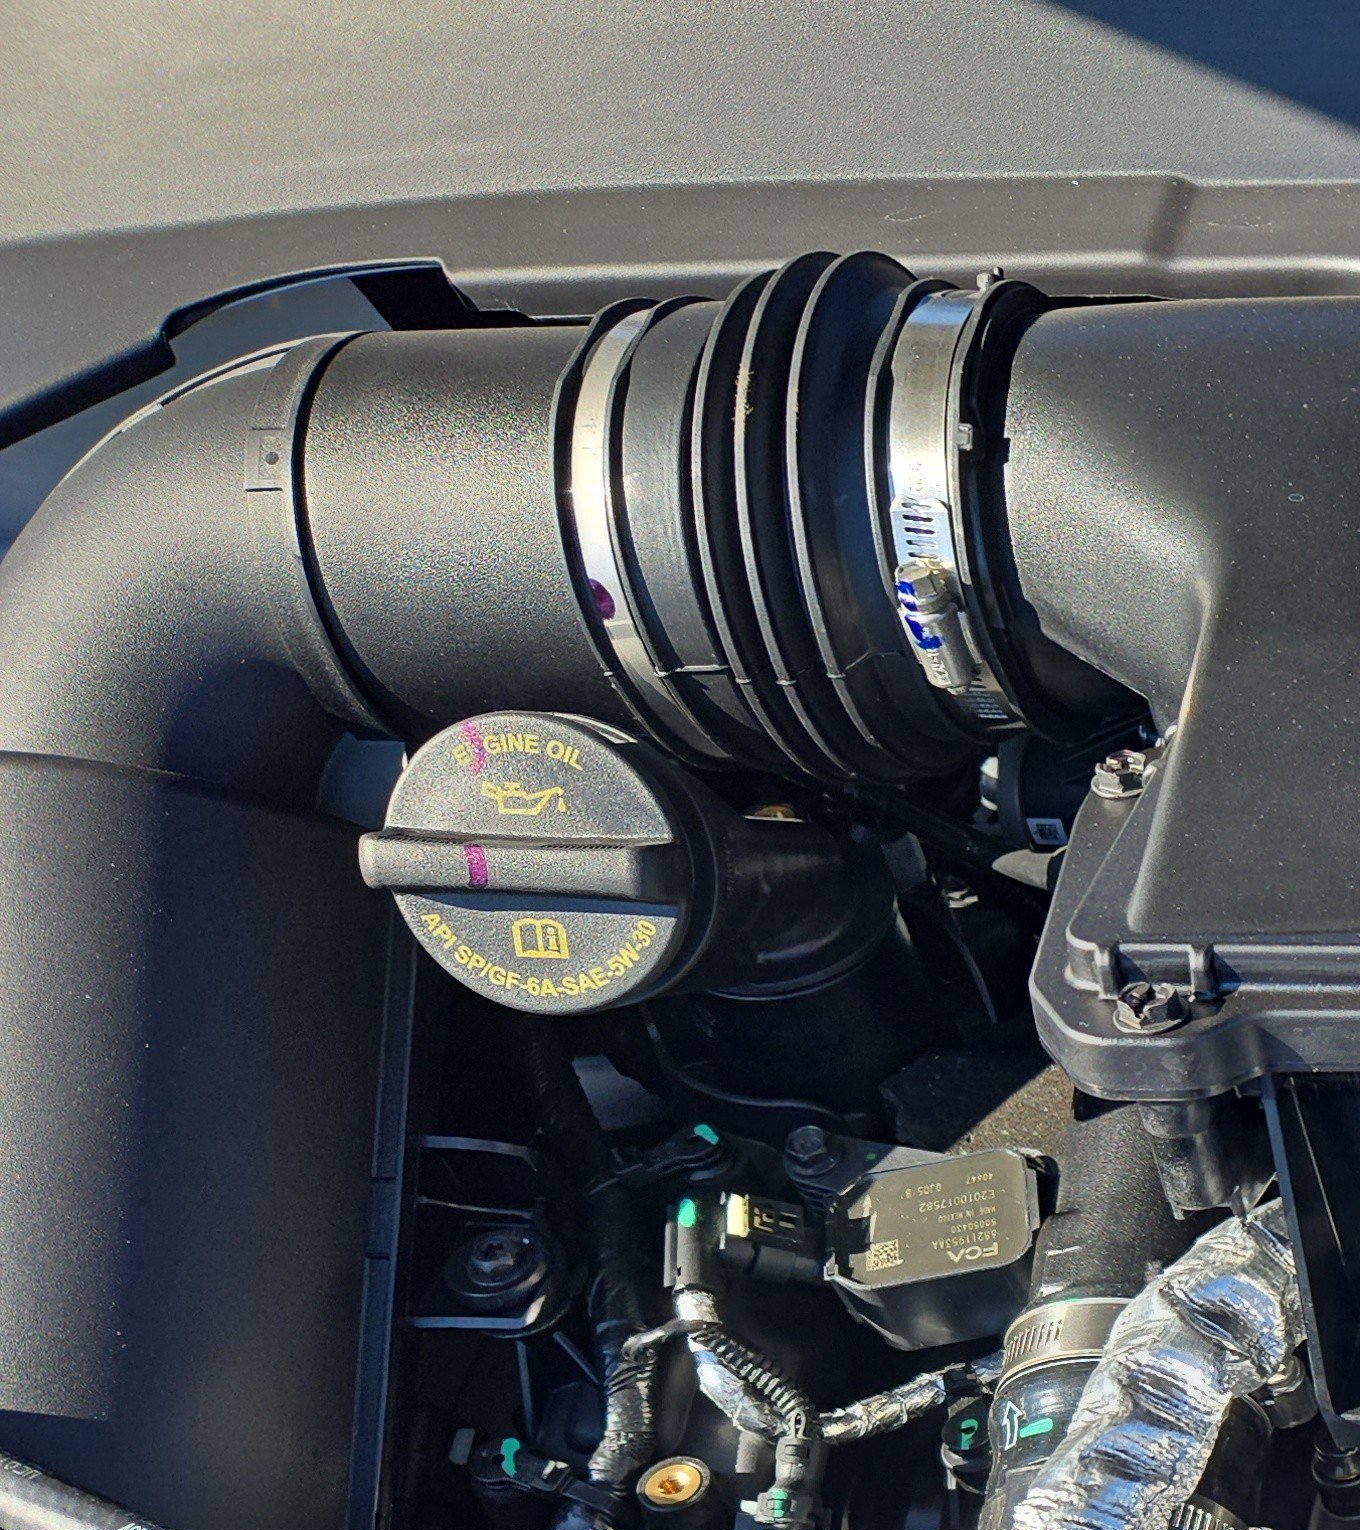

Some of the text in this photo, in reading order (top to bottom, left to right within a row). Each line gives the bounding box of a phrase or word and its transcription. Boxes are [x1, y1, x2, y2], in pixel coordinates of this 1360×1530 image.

[450, 734, 584, 772] EGINE OIL
[420, 912, 457, 950] API
[947, 1242, 999, 1263] FCA
